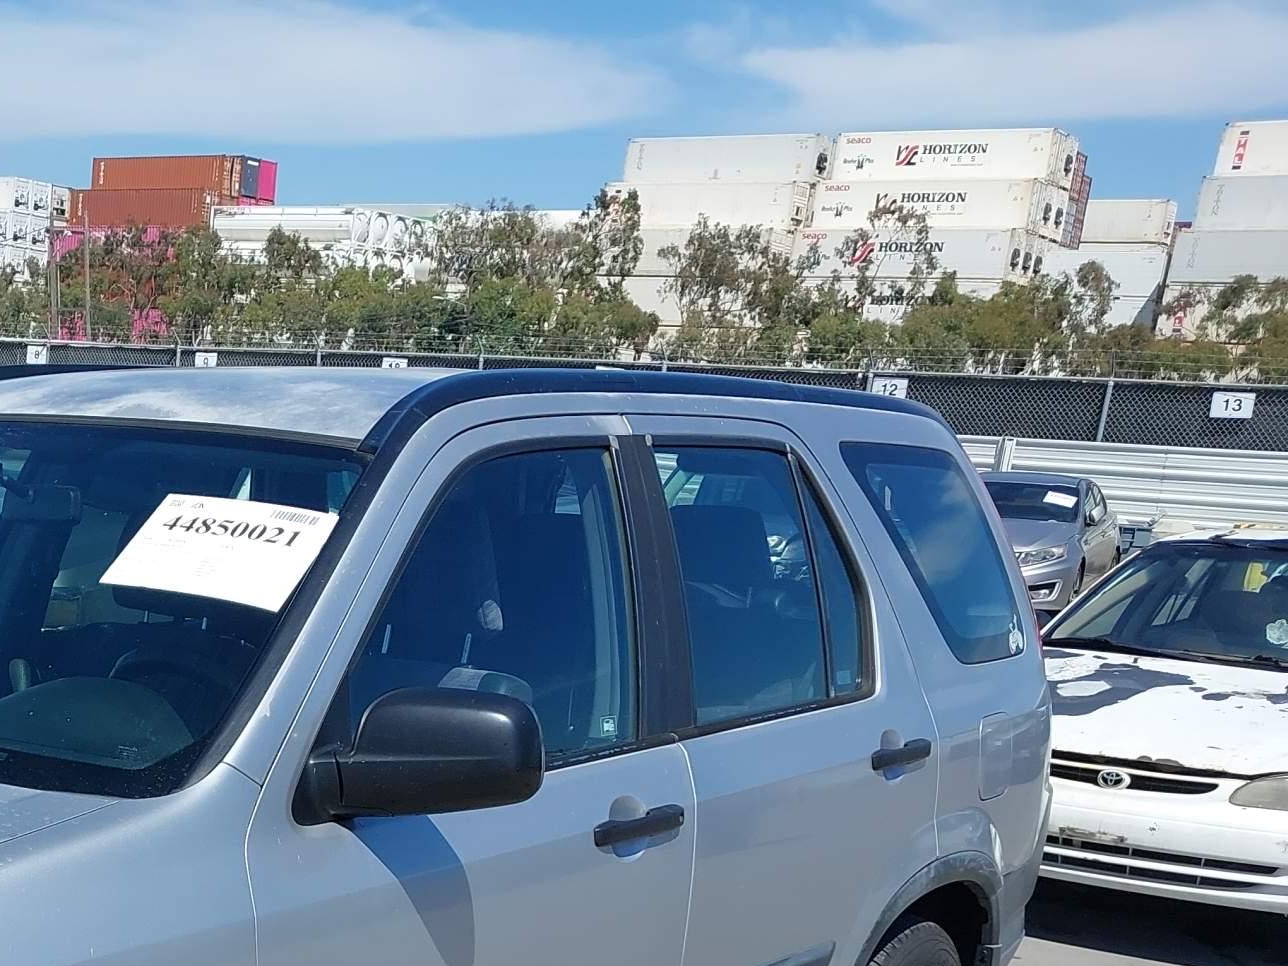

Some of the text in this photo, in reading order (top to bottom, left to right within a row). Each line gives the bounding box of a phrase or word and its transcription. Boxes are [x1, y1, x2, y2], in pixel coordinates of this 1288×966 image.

[846, 136, 872, 144] seaco
[922, 143, 989, 155] HORIZON
[919, 155, 977, 163] LINES
[824, 184, 851, 192] seaco
[900, 192, 968, 203] HORIZON
[801, 232, 828, 240] seaco
[34, 351, 40, 360] 8
[881, 382, 898, 397] 12
[1222, 397, 1243, 413] 13
[163, 514, 303, 548] 44850021
